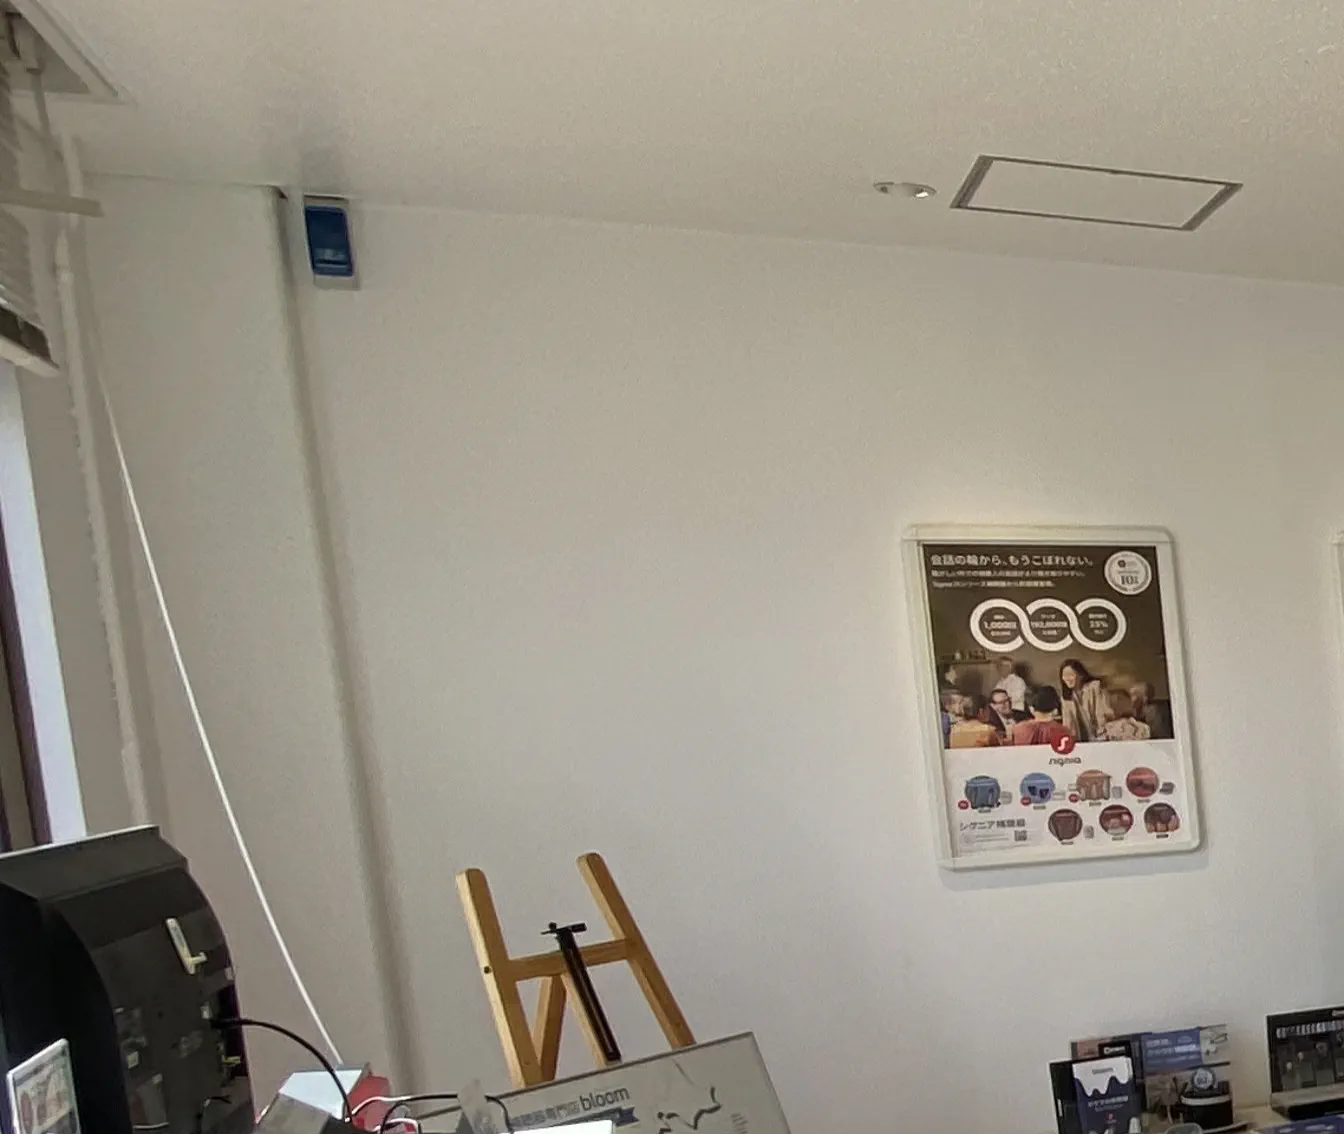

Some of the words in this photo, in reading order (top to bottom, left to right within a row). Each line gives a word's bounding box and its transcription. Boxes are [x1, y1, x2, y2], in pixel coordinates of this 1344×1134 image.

[931, 554, 1094, 566] 会話の輪から、もうこぼれない。
[959, 818, 1026, 831] シグニア補聴器
[580, 1087, 631, 1111] bloom
